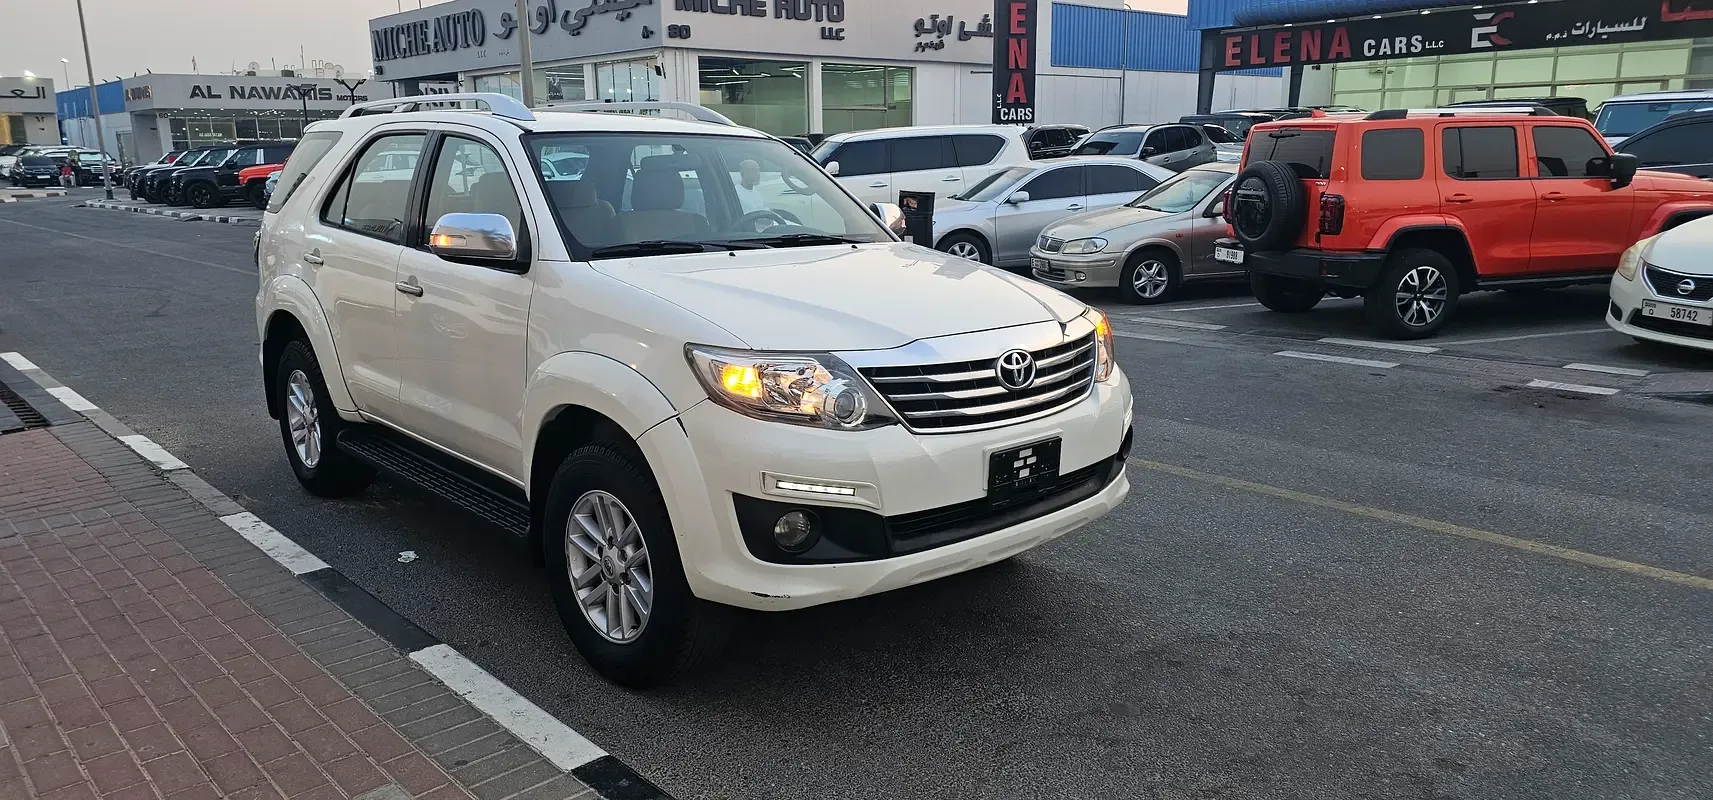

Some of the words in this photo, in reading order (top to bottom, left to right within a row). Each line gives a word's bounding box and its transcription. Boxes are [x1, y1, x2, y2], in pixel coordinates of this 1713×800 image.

[774, 0, 845, 22] AUTO
[371, 19, 431, 62] MICHE
[432, 8, 486, 53] AUTO
[820, 27, 845, 40] LLC
[1571, 16, 1648, 38] للسيارات
[1225, 27, 1352, 66] ELENA
[1363, 35, 1423, 57] CARS
[190, 85, 222, 99] AL
[1000, 108, 1033, 120] CARS
[1670, 307, 1698, 322] 58742
